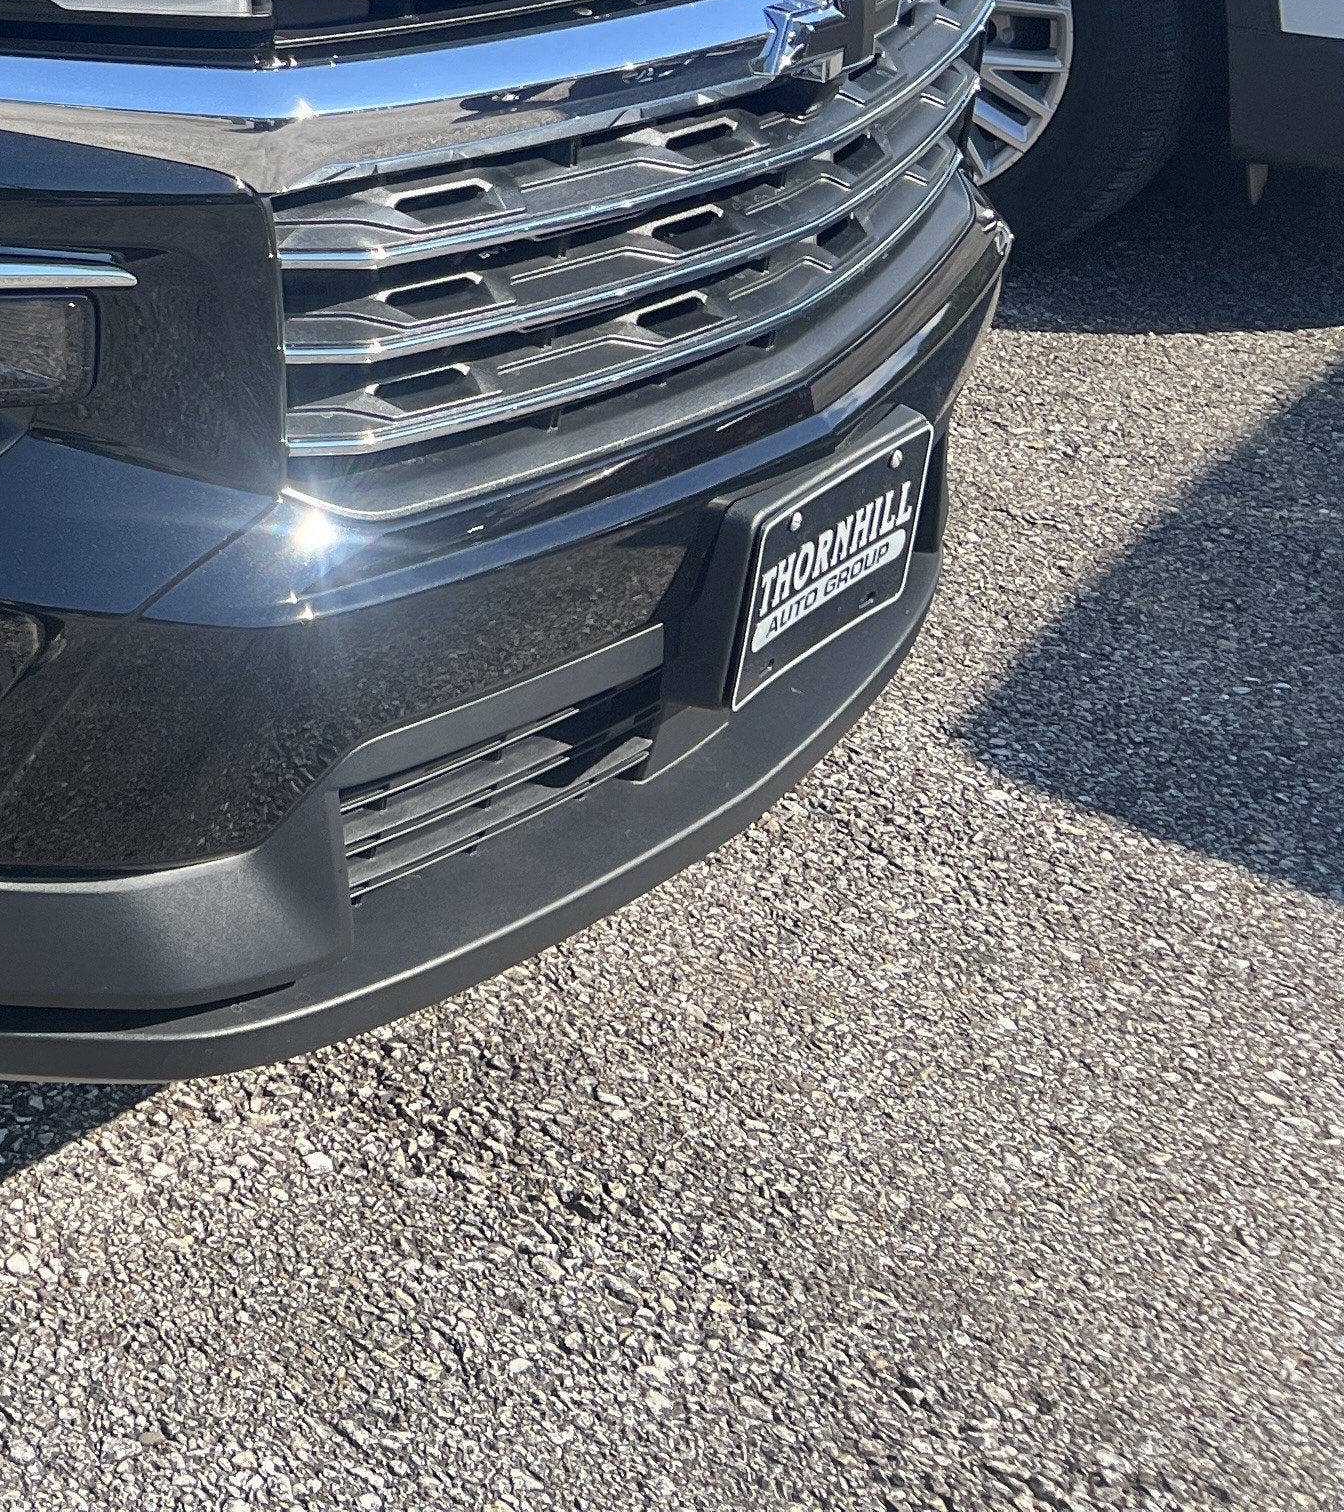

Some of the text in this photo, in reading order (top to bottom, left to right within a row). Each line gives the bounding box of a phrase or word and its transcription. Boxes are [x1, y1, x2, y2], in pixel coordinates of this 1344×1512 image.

[758, 479, 914, 618] THORNHILL
[765, 541, 890, 639] AUTO GROUP
